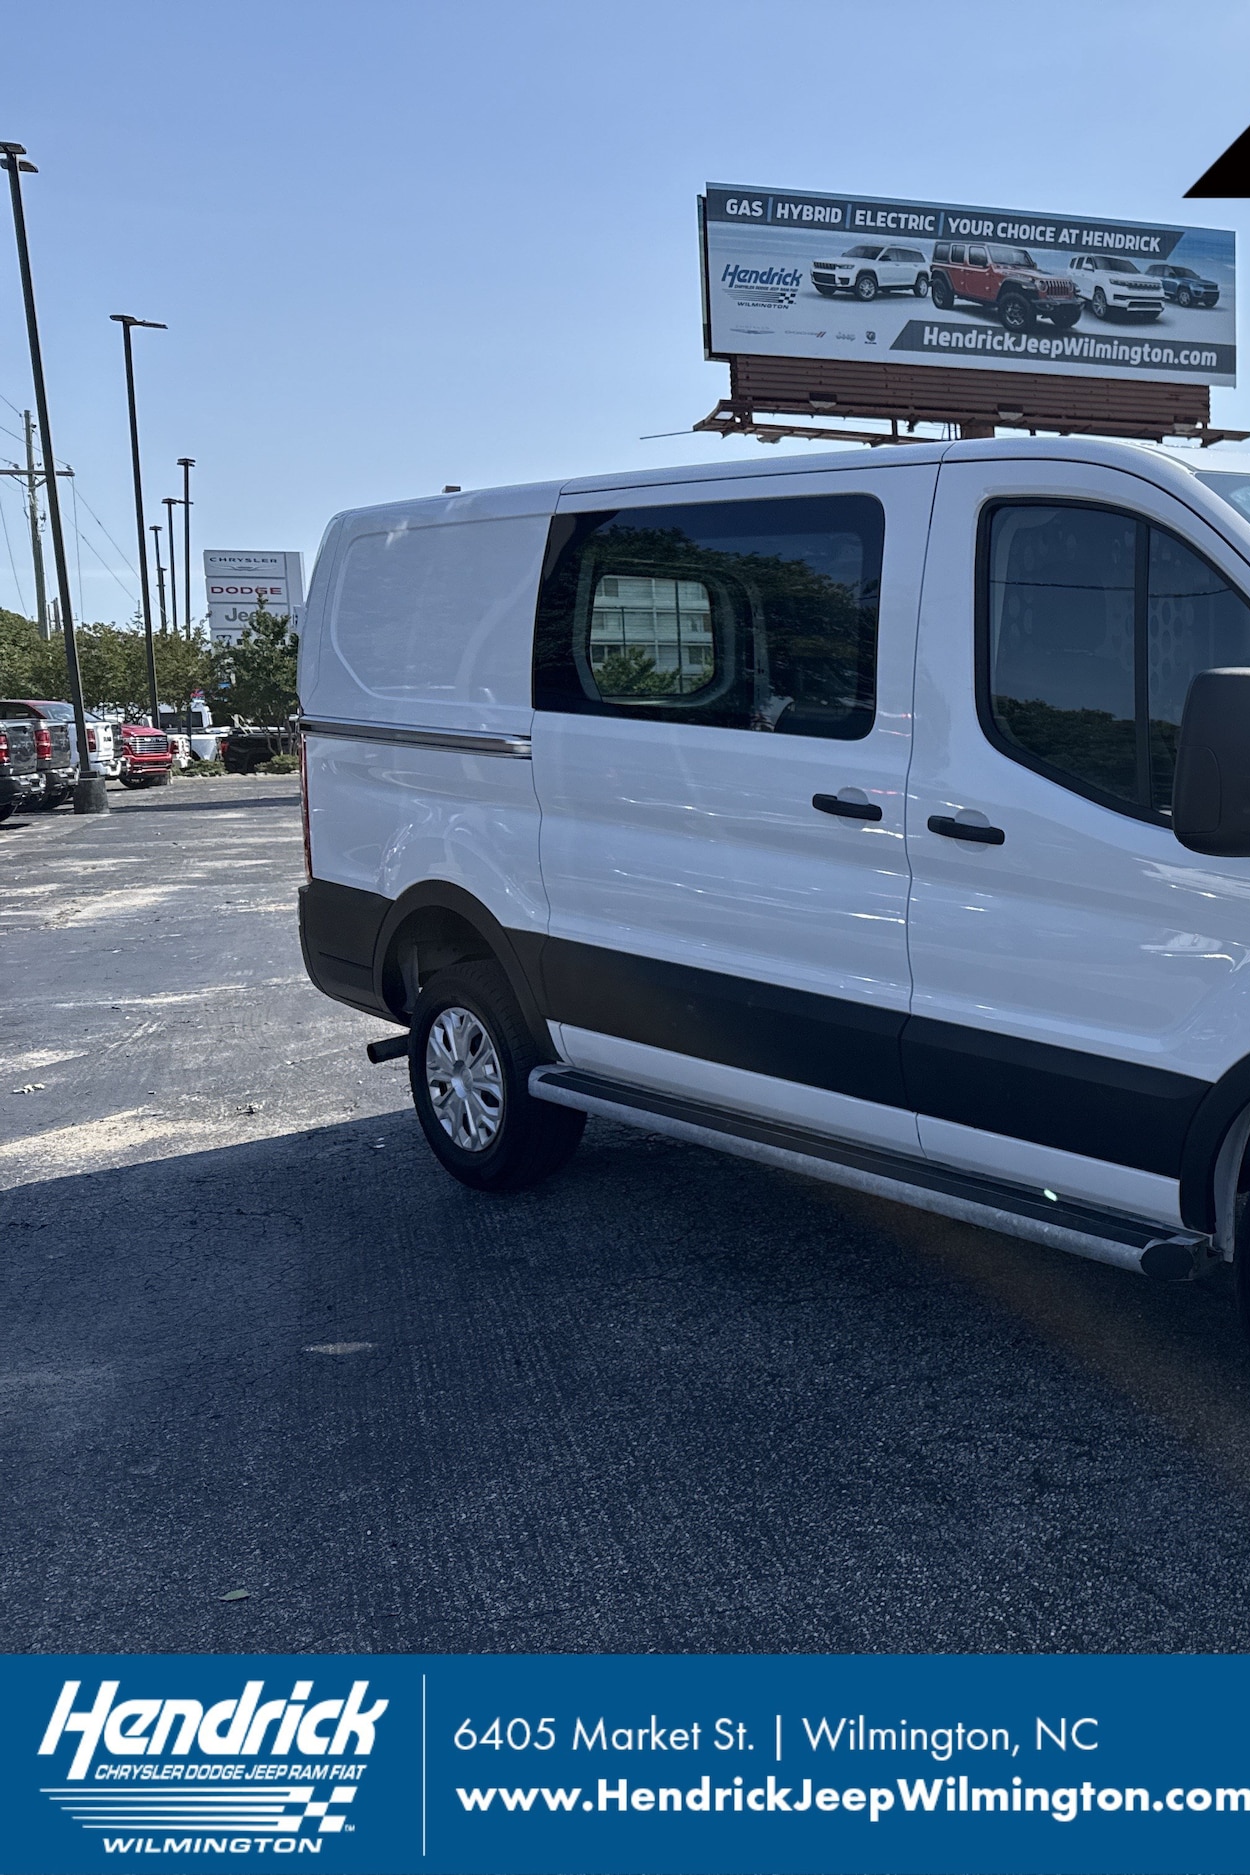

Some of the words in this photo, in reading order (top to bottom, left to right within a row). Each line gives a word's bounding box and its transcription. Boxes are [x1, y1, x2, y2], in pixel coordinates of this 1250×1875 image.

[725, 198, 763, 217] GAS
[776, 202, 842, 224] HYBRID
[854, 209, 936, 231] ELECTRIC
[948, 217, 993, 237] YOUR
[996, 222, 1055, 243] CHOICE
[1058, 228, 1080, 245] AT
[1081, 231, 1161, 252] HENDRICK
[721, 264, 803, 287] Hendrick
[737, 301, 789, 309] WILMINGTON
[923, 326, 1218, 367] HendrickJeepWilmington.com
[210, 586, 282, 594] DODGE
[225, 608, 272, 621] Jee
